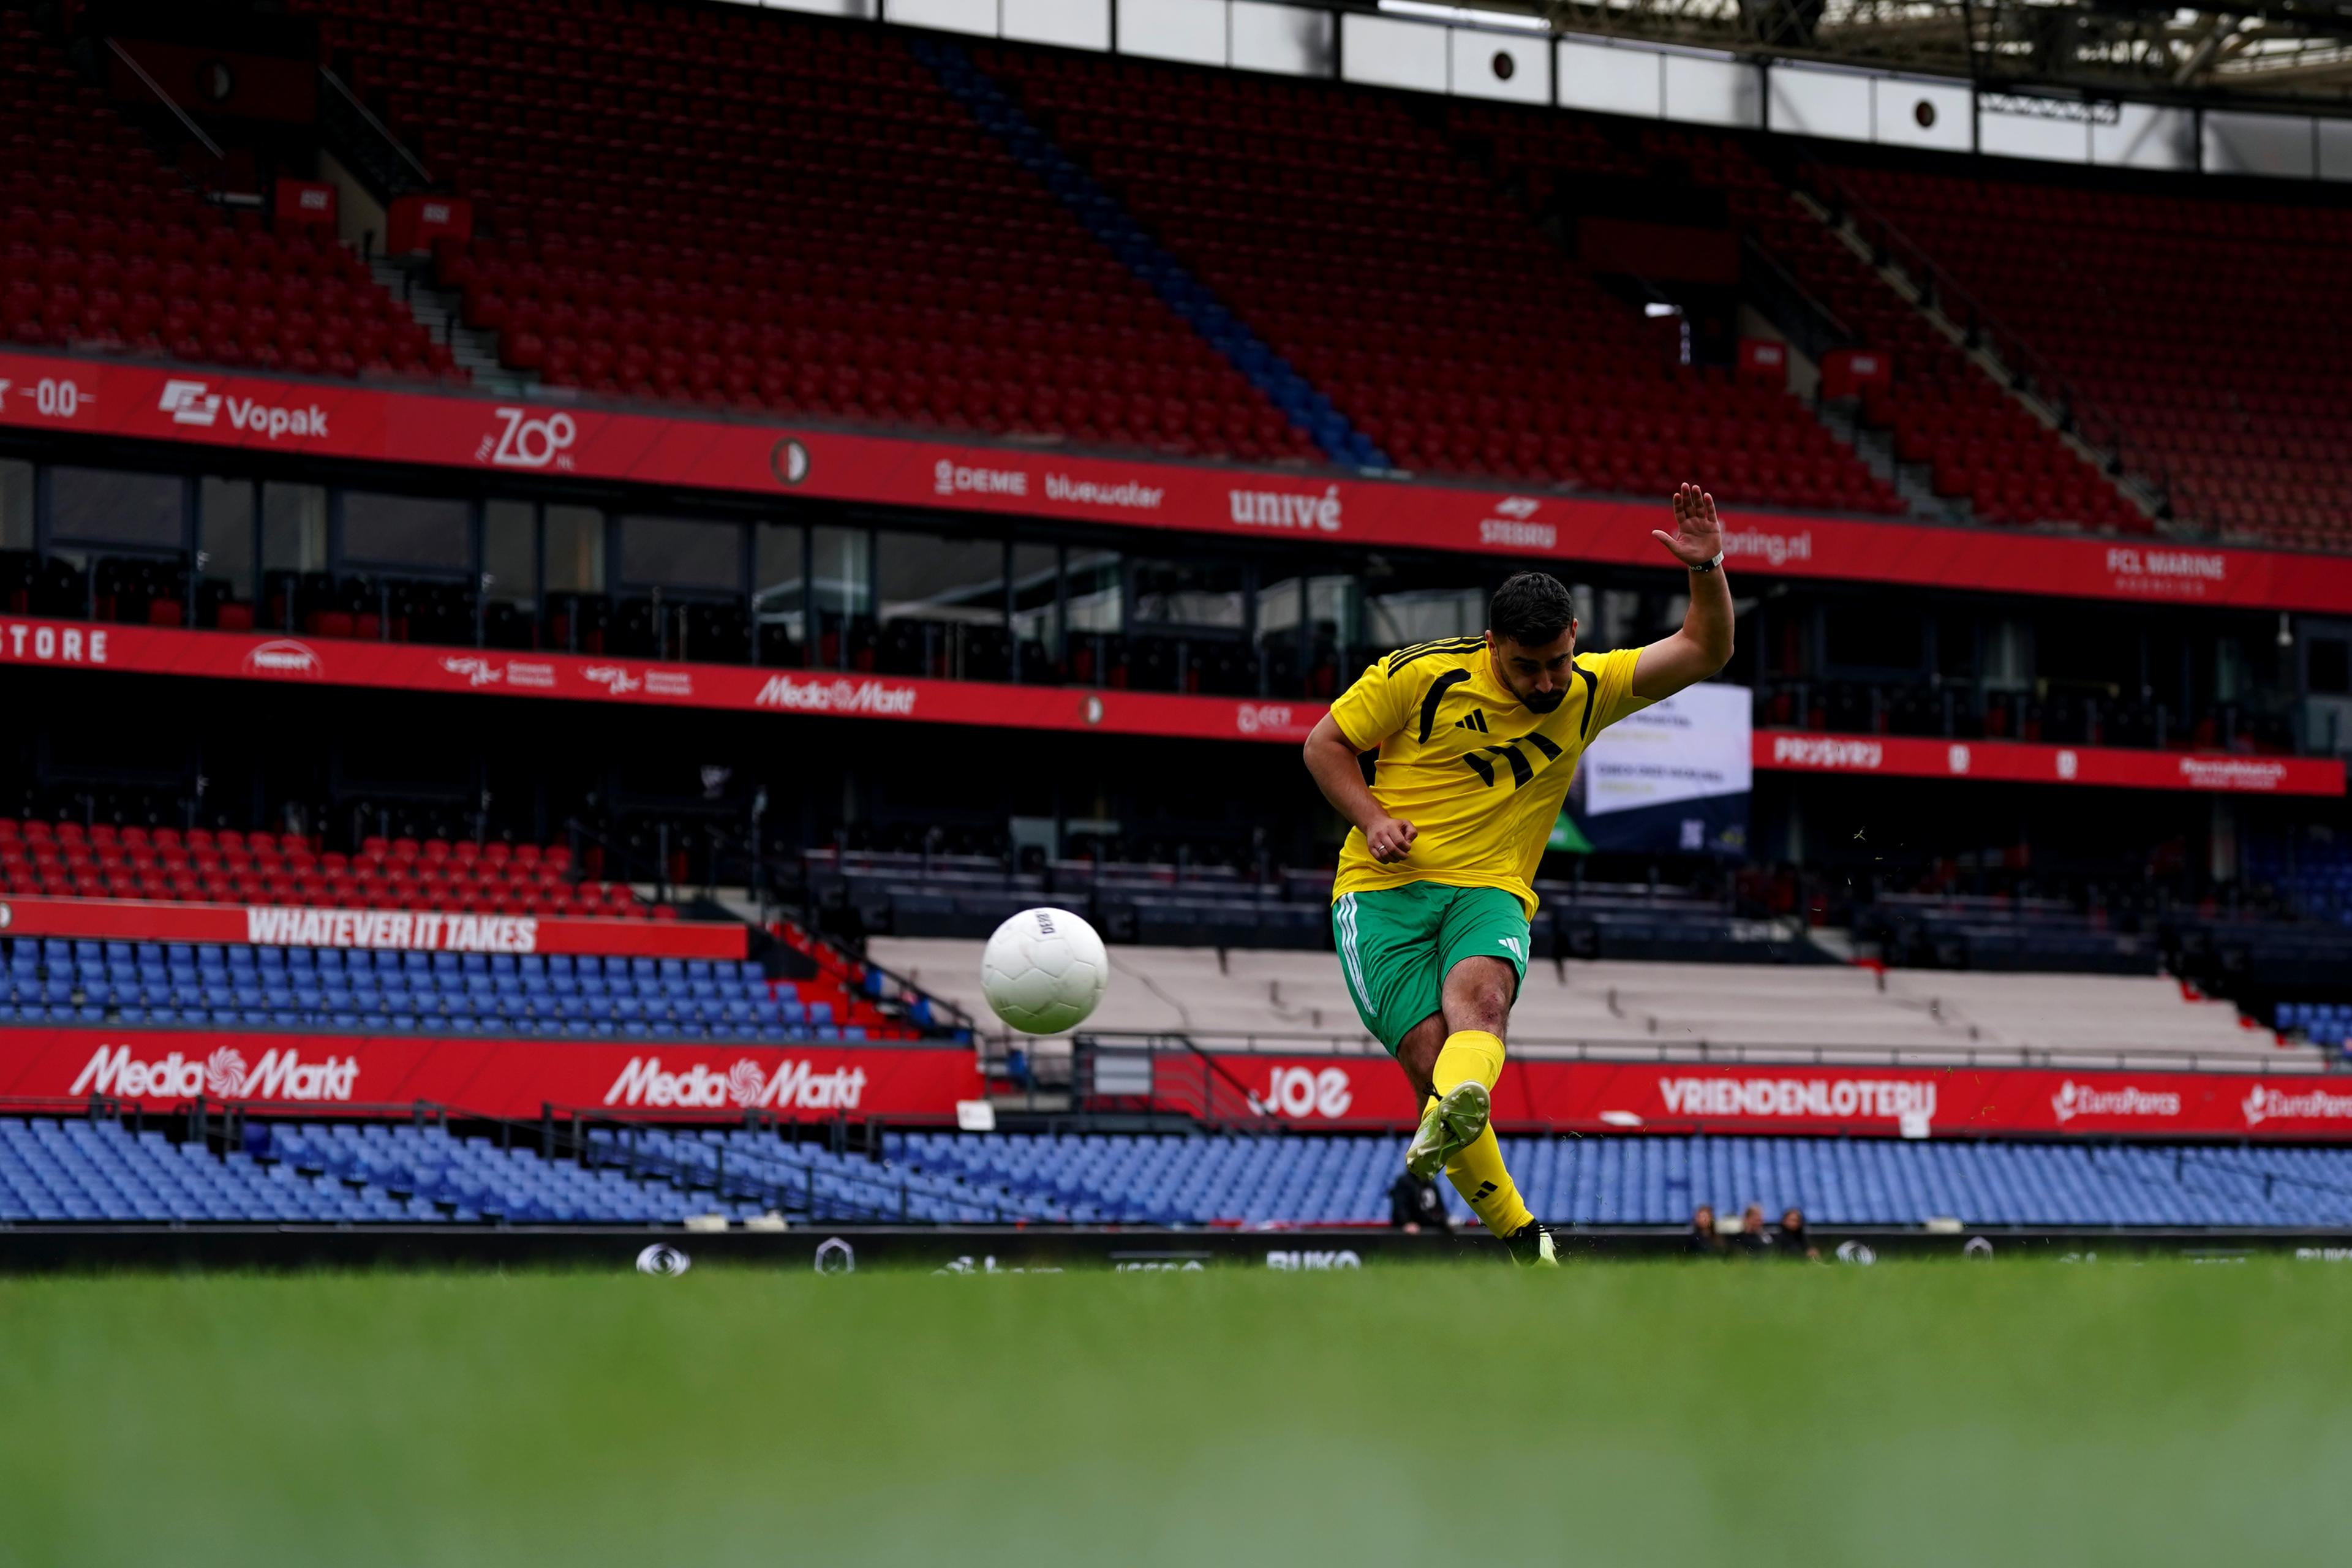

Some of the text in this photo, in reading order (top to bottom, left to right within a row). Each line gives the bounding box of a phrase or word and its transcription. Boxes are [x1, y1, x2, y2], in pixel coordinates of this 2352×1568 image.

[226, 395, 328, 439] Vopak
[955, 467, 1027, 496] DEME
[1045, 473, 1163, 508] bluewater
[1229, 486, 1342, 532] univé
[1719, 519, 1811, 566] oning.nl
[0, 623, 108, 663] TORE
[246, 906, 538, 952] WHATEVER IT TAKES
